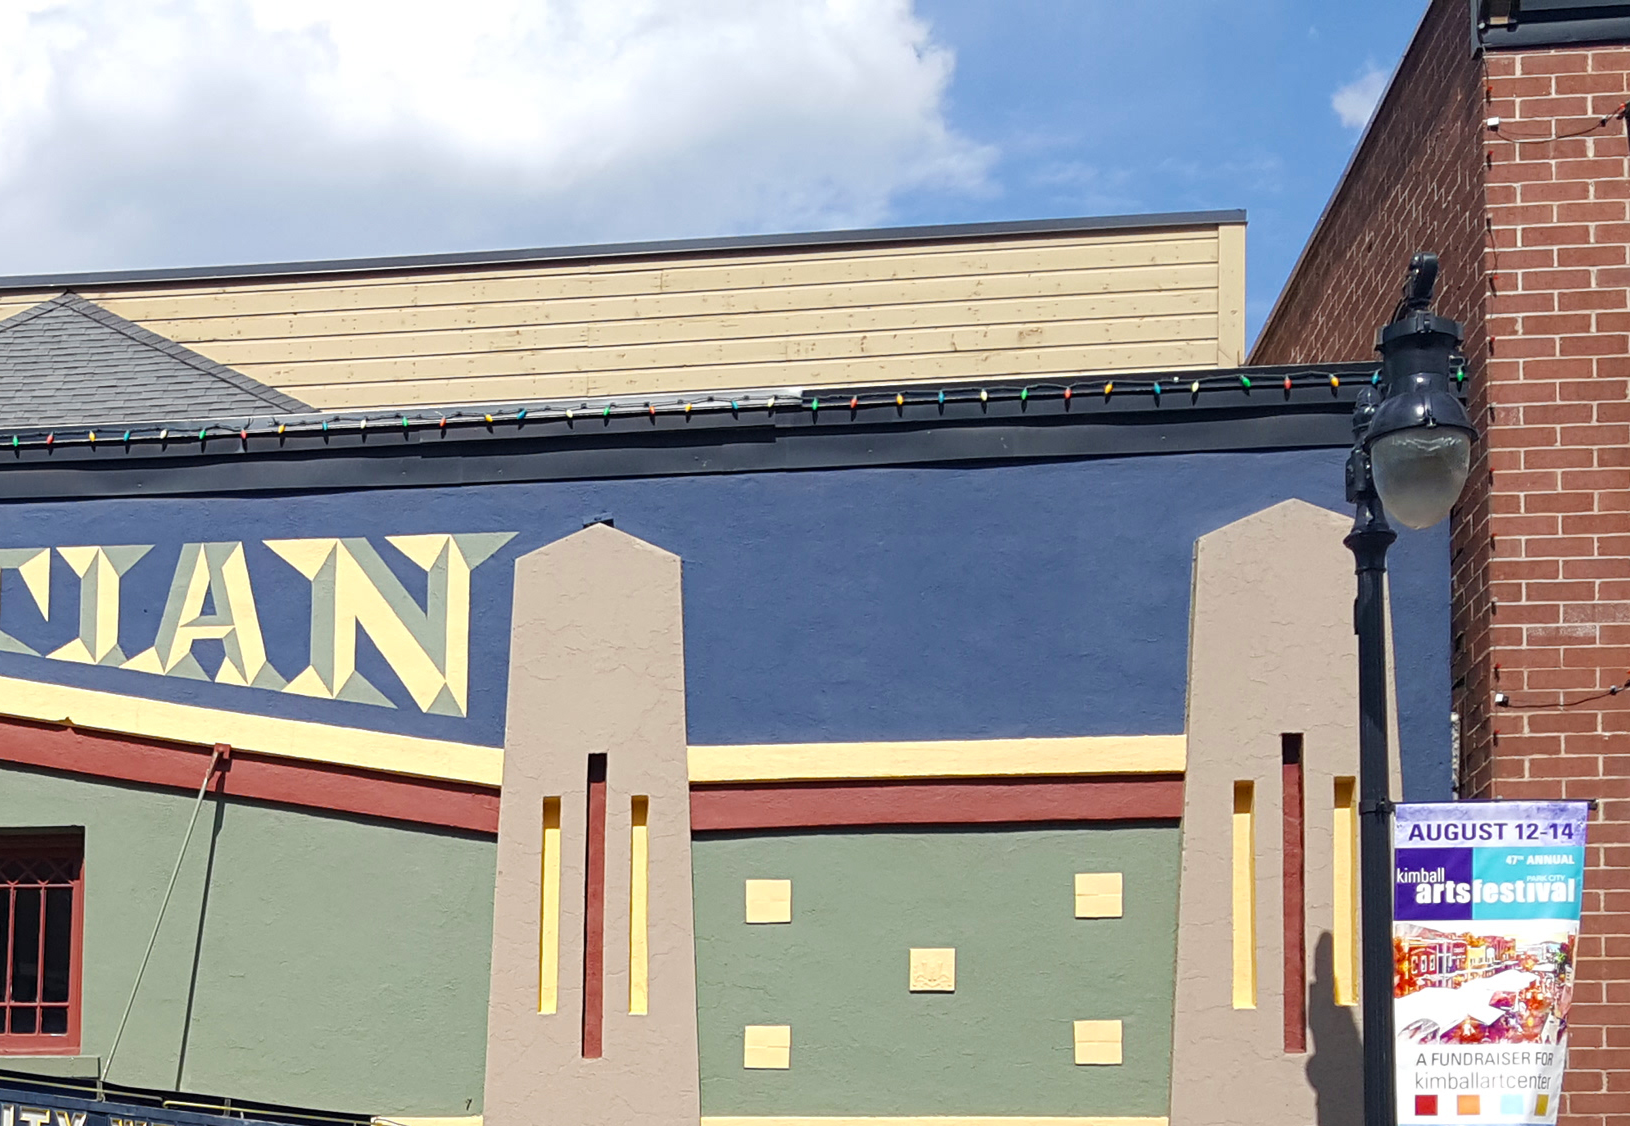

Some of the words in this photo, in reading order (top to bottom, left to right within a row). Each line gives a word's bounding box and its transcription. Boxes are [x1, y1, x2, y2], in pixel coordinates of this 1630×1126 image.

[1408, 823, 1508, 841] AUGUST
[1515, 823, 1573, 840] 12-14
[1526, 854, 1575, 865] ANNUAL
[1396, 867, 1445, 883] kimball
[1416, 1053, 1427, 1066] A
[1432, 1052, 1531, 1067] FUNDRAISER
[1535, 1052, 1554, 1066] FOR
[1415, 1072, 1552, 1090] kimballartcenter
